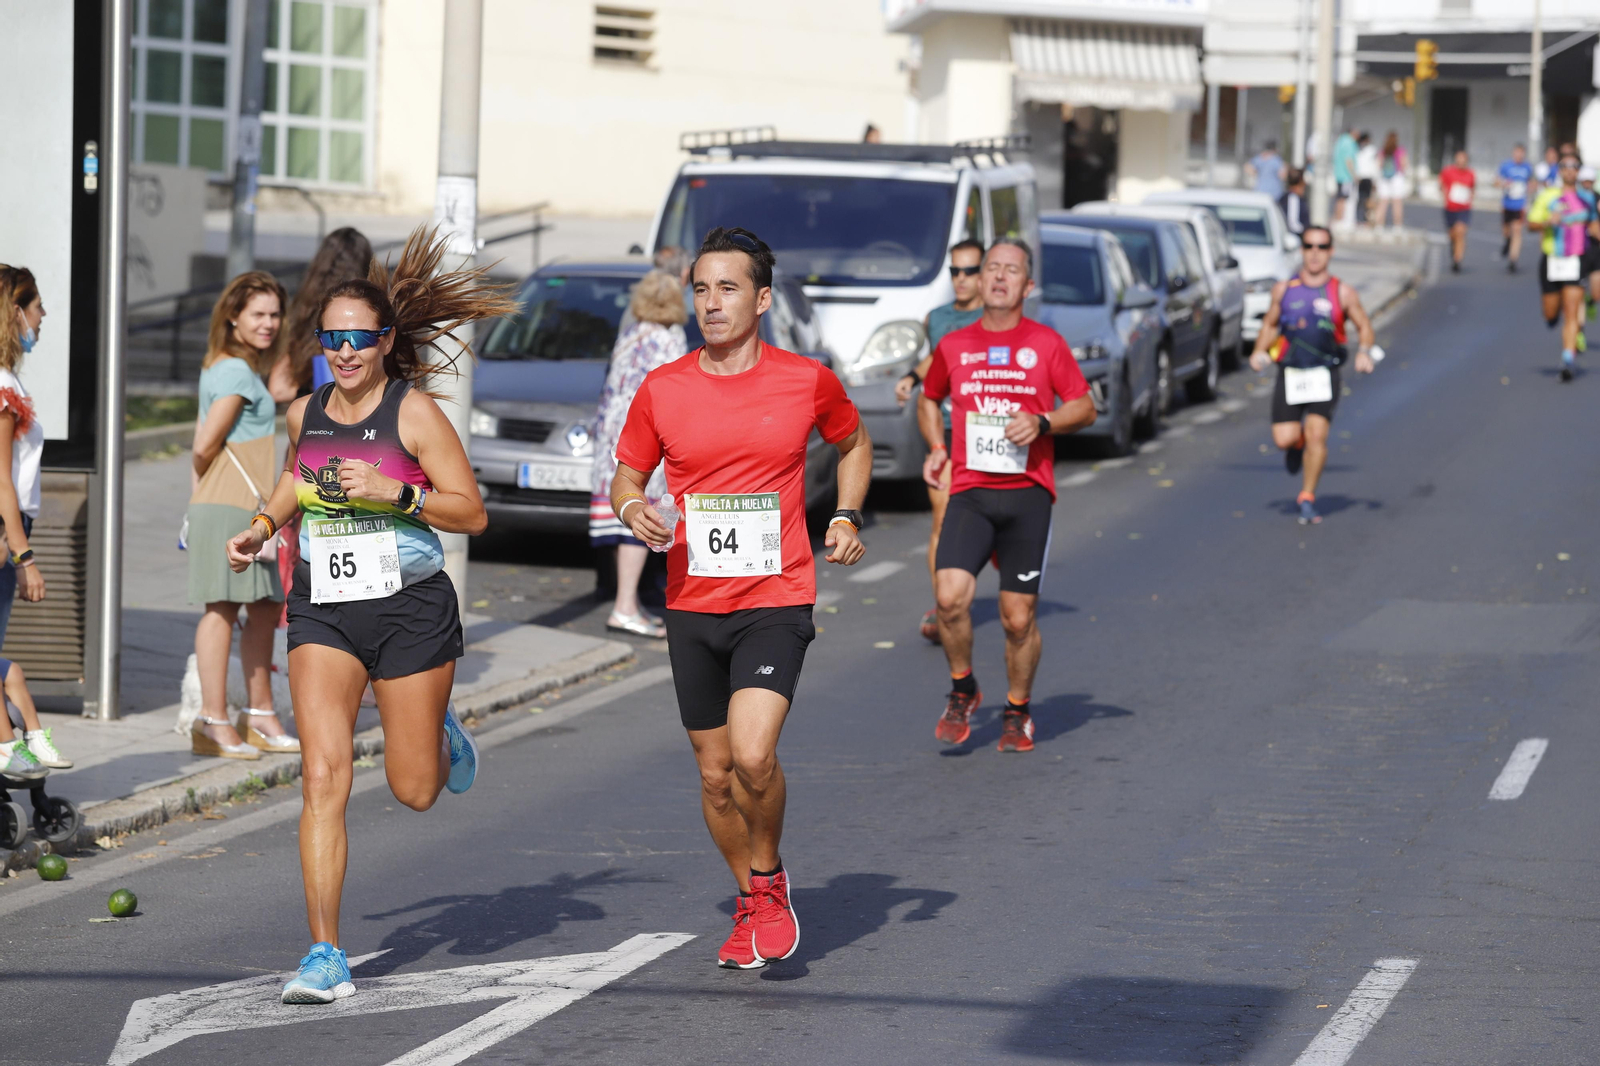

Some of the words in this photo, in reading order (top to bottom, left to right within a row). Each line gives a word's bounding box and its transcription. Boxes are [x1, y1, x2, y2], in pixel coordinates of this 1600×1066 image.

[971, 369, 1026, 380] ATLETISMO
[984, 384, 1037, 395] FERTILIDAD
[691, 498, 700, 510] 34
[702, 498, 731, 510] VUELTA
[734, 498, 740, 510] A
[742, 497, 773, 510] HUELVA
[321, 522, 346, 535] VUELTA
[347, 522, 354, 534] A
[355, 519, 387, 533] HUELVA
[325, 537, 349, 545] MÓNICA
[708, 527, 739, 554] 64
[329, 551, 357, 580] 65
